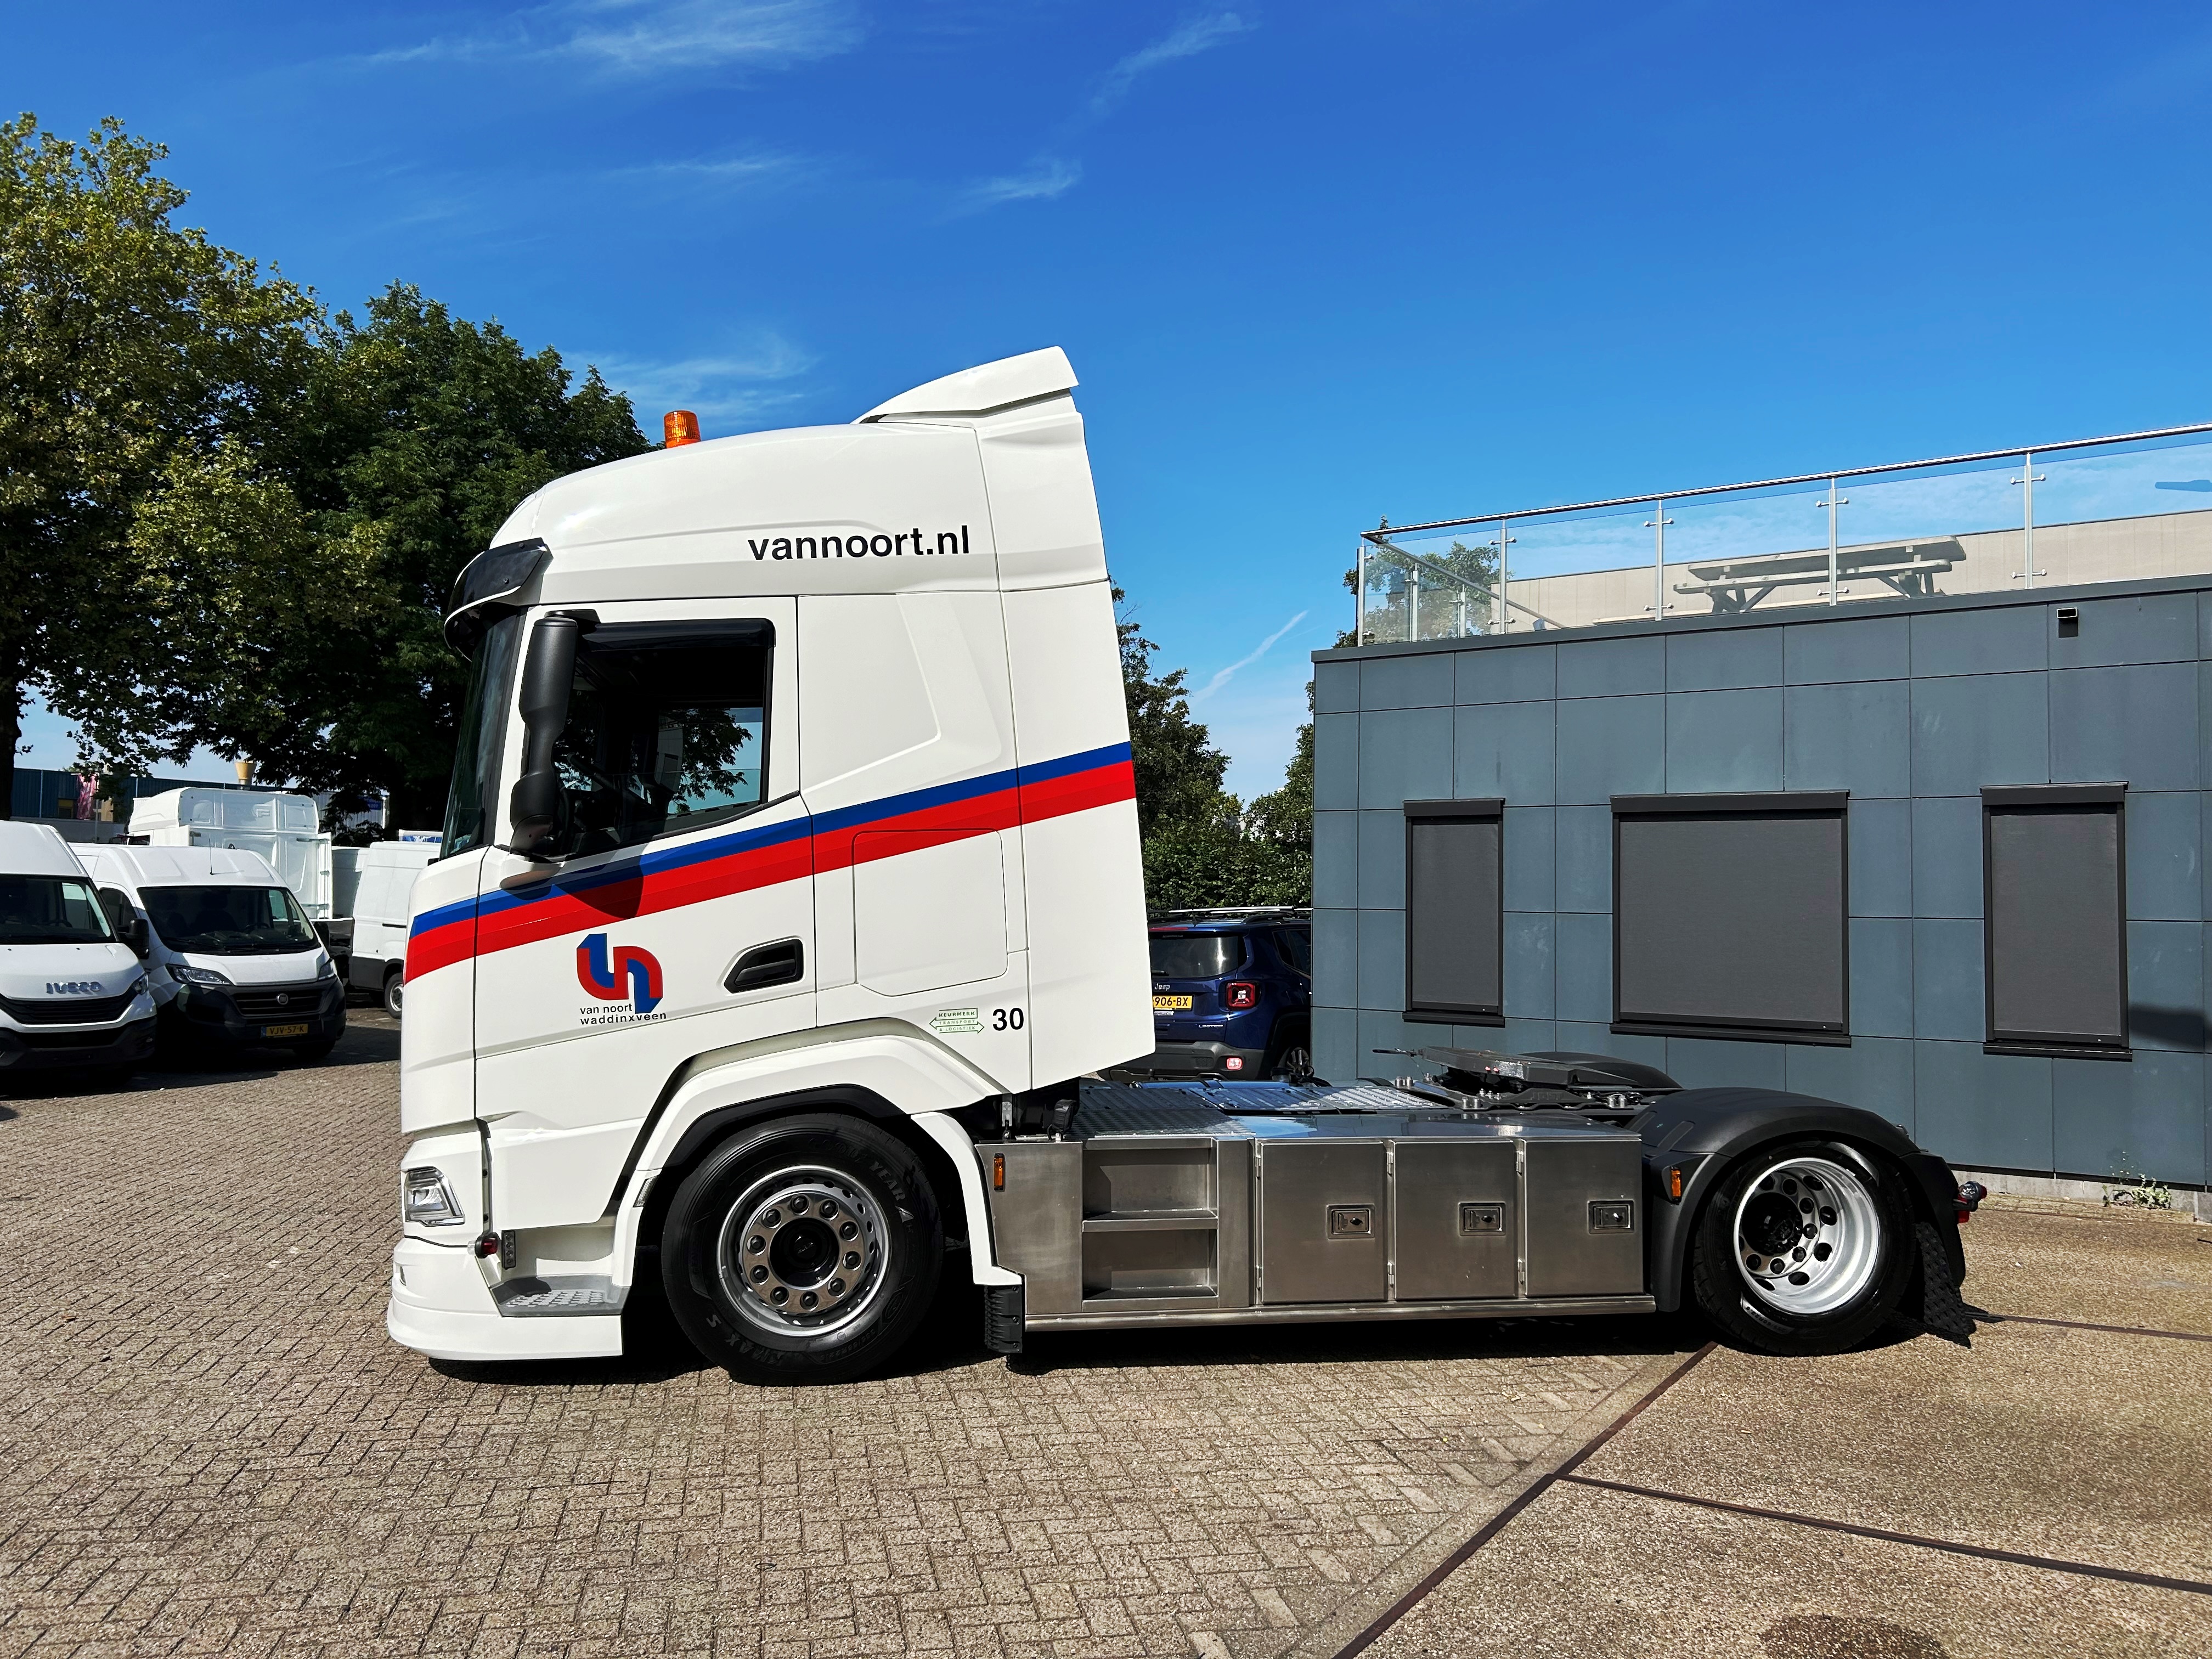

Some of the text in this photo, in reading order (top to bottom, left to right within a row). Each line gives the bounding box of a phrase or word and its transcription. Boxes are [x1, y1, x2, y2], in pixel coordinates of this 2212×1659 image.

[747, 524, 969, 561] vannoort.nl
[46, 981, 101, 994] IVECO
[580, 1003, 633, 1014] van noort
[580, 1012, 667, 1025] waddinxveen
[992, 1007, 1024, 1031] 30
[269, 1025, 304, 1035] VJV-57-K
